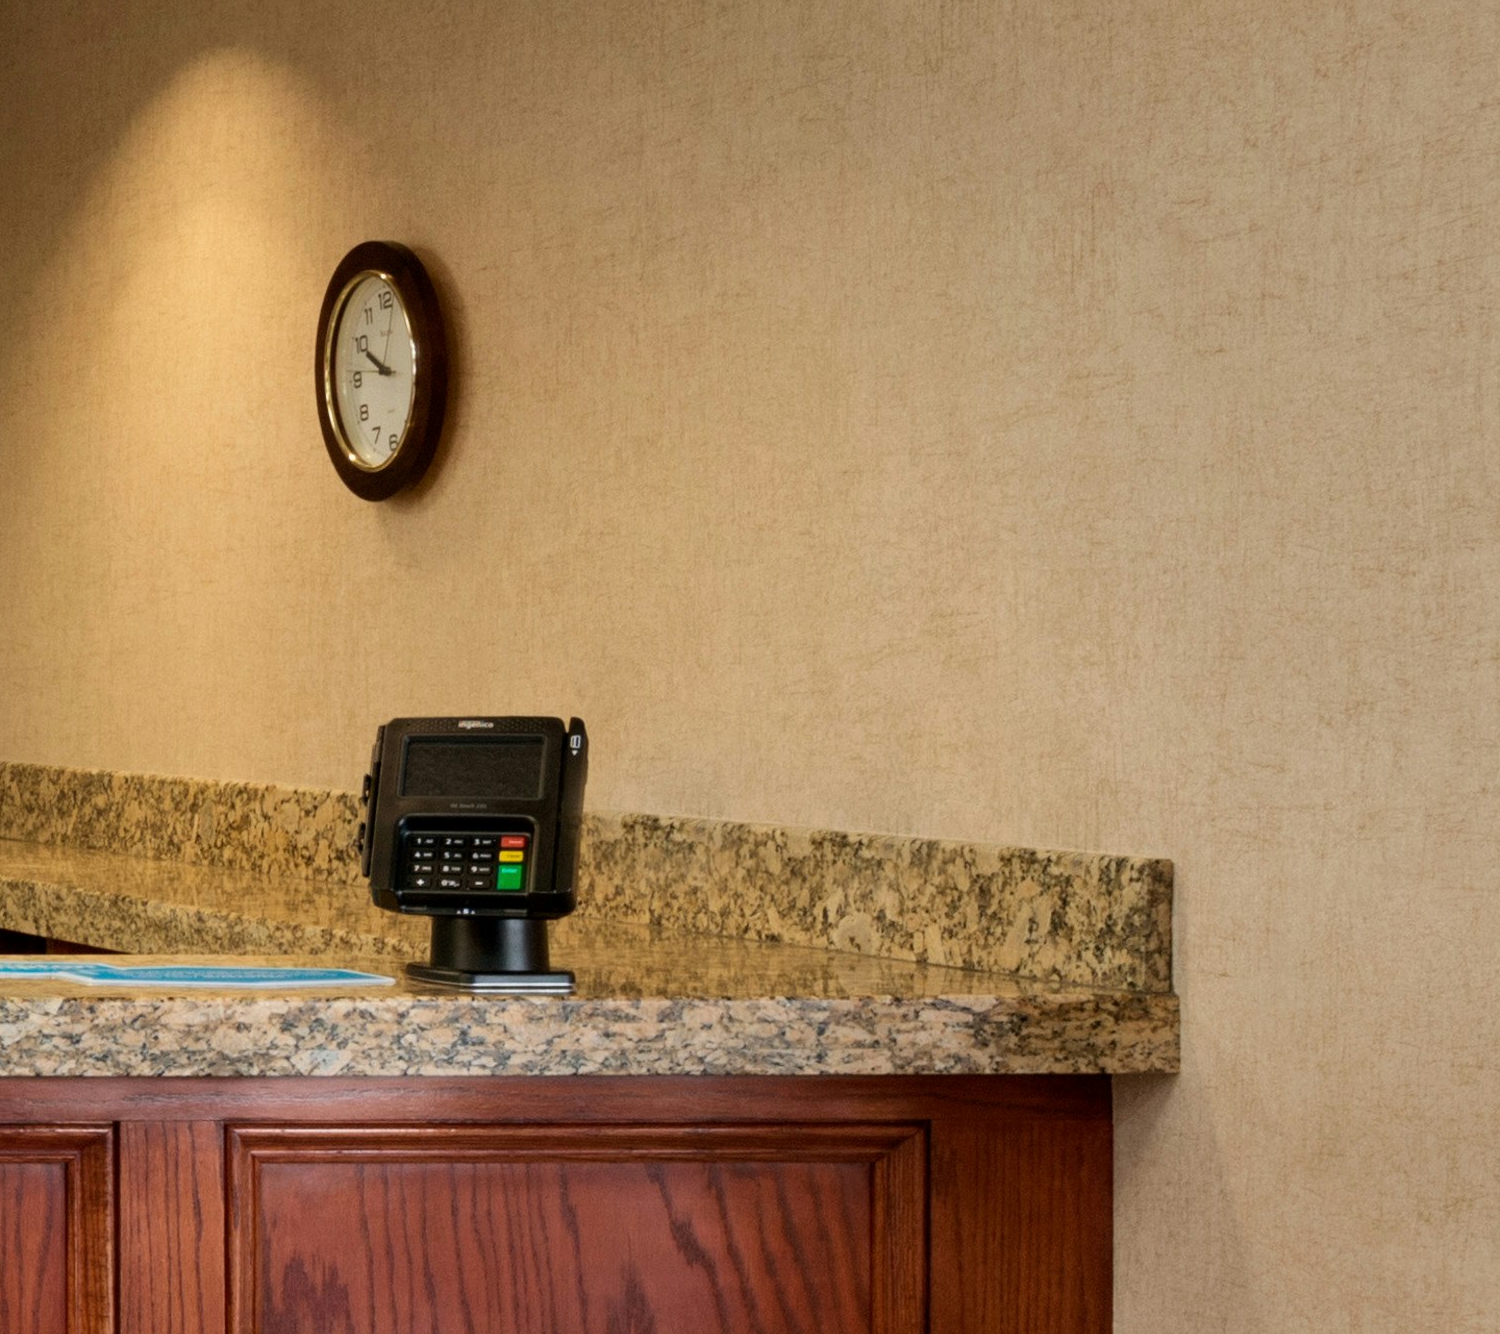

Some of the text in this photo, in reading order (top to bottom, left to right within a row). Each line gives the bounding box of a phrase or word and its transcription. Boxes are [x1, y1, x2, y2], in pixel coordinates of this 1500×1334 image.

[377, 290, 393, 310] 12
[364, 306, 374, 326] 11
[354, 334, 368, 354] 10
[352, 370, 362, 390] 9
[359, 403, 370, 422] 8
[372, 425, 381, 445] 7
[388, 433, 399, 452] 6
